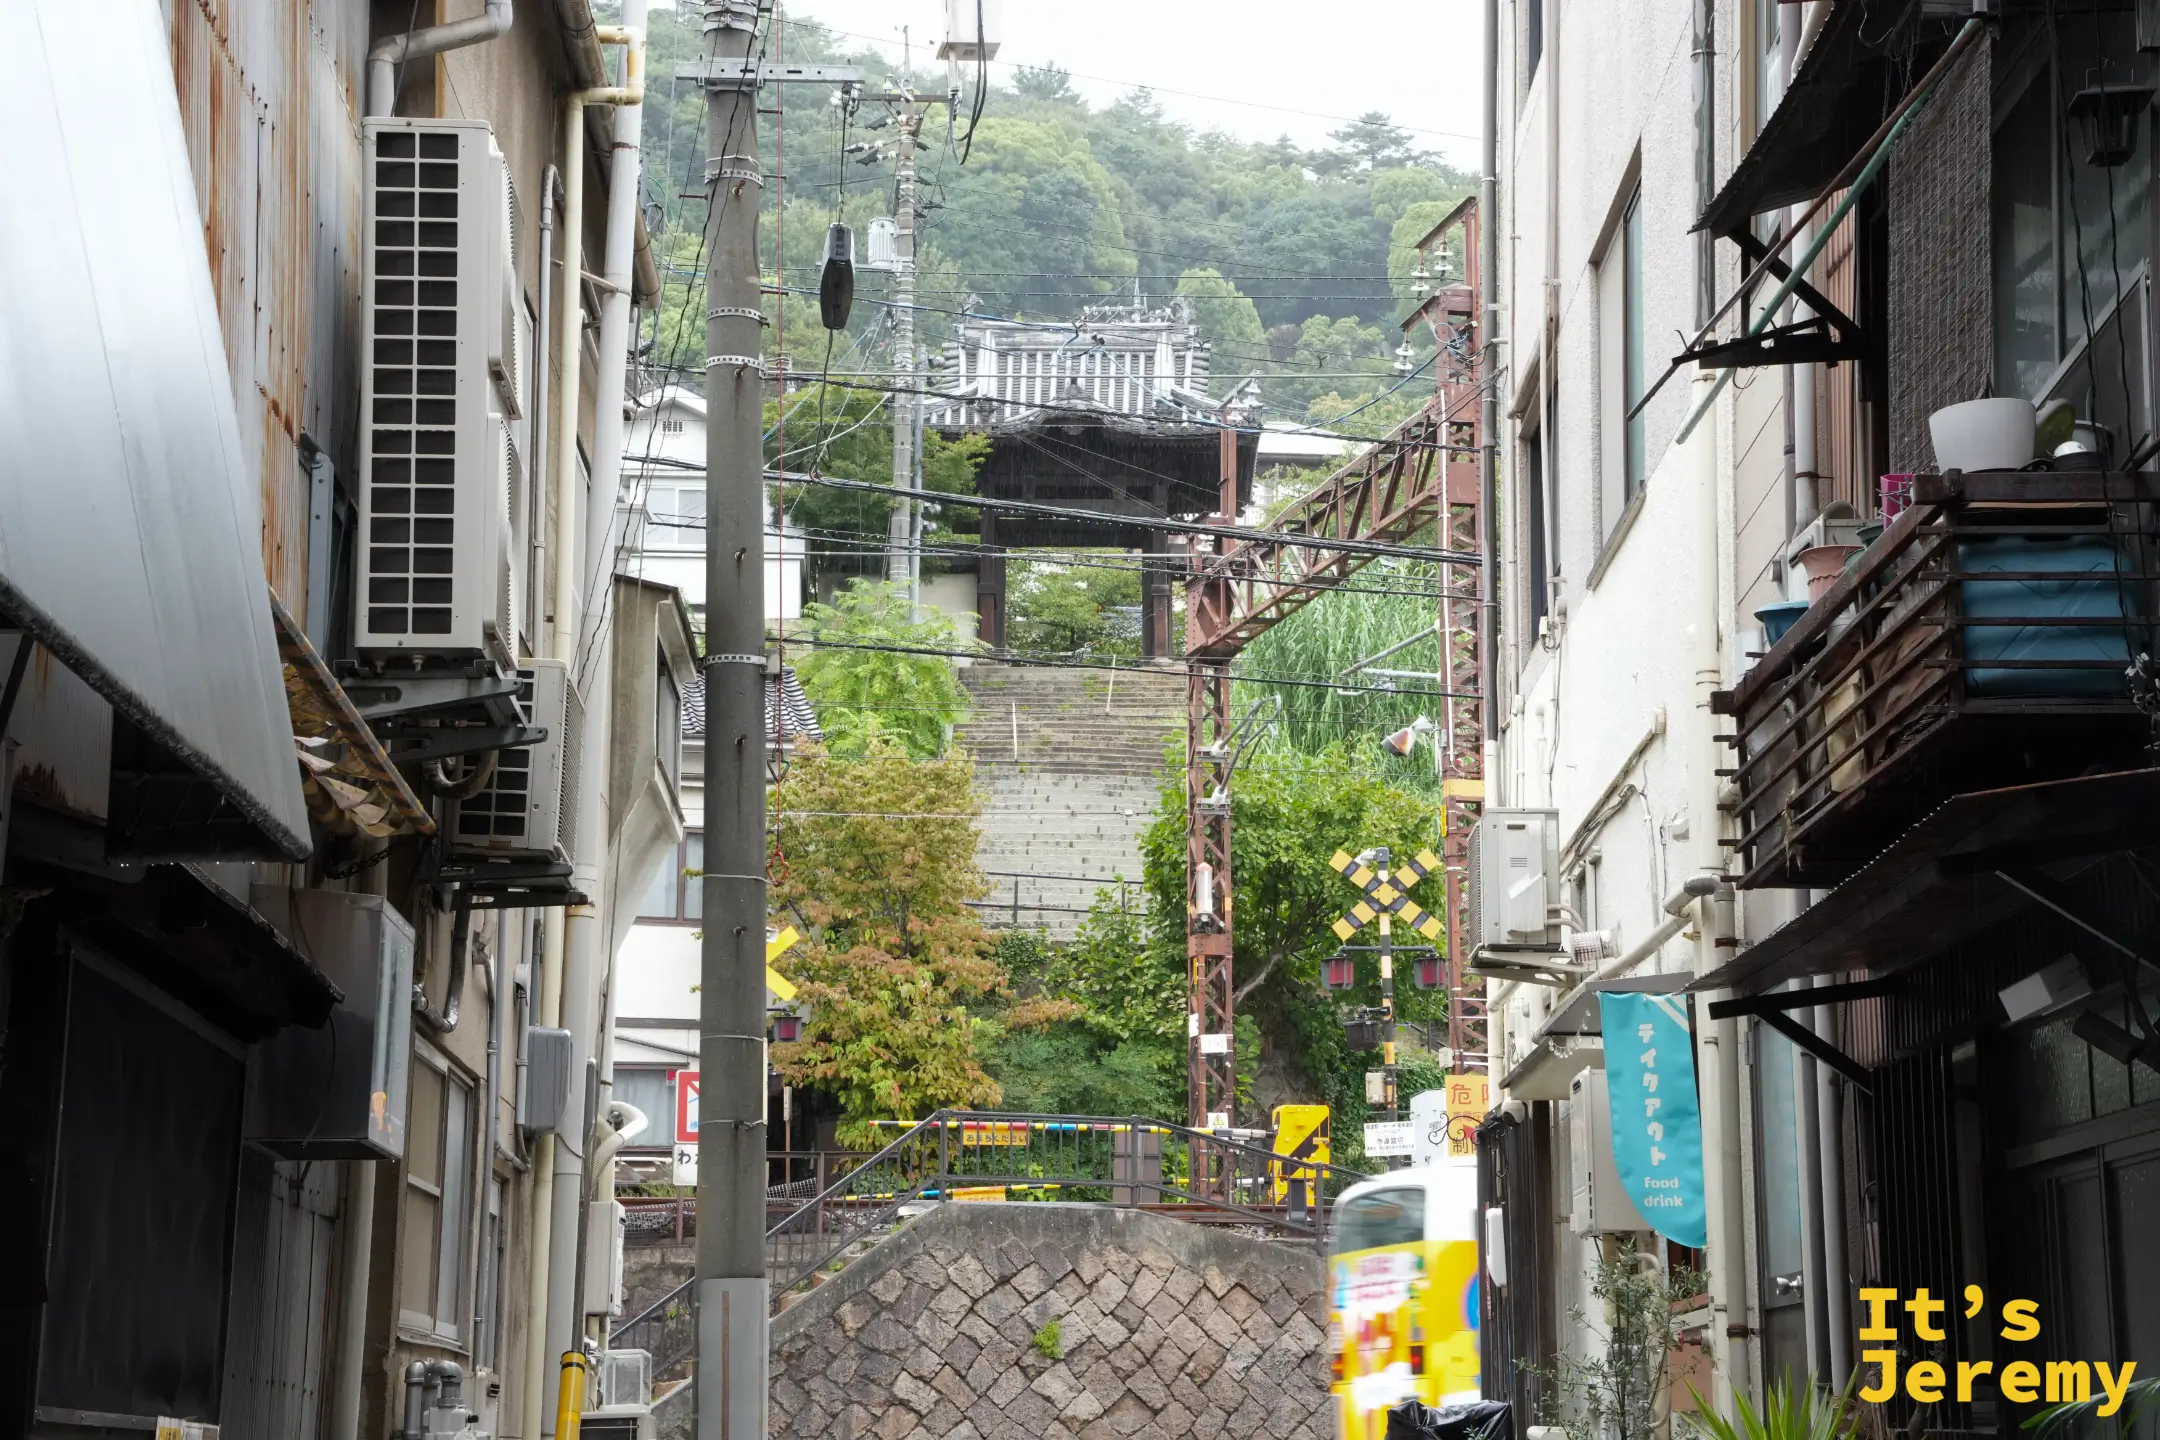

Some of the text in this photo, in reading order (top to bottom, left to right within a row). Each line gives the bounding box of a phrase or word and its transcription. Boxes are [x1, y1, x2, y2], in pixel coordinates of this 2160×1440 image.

[1638, 1023, 1666, 1166] テイクアウト
[1644, 1194, 1683, 1208] drink
